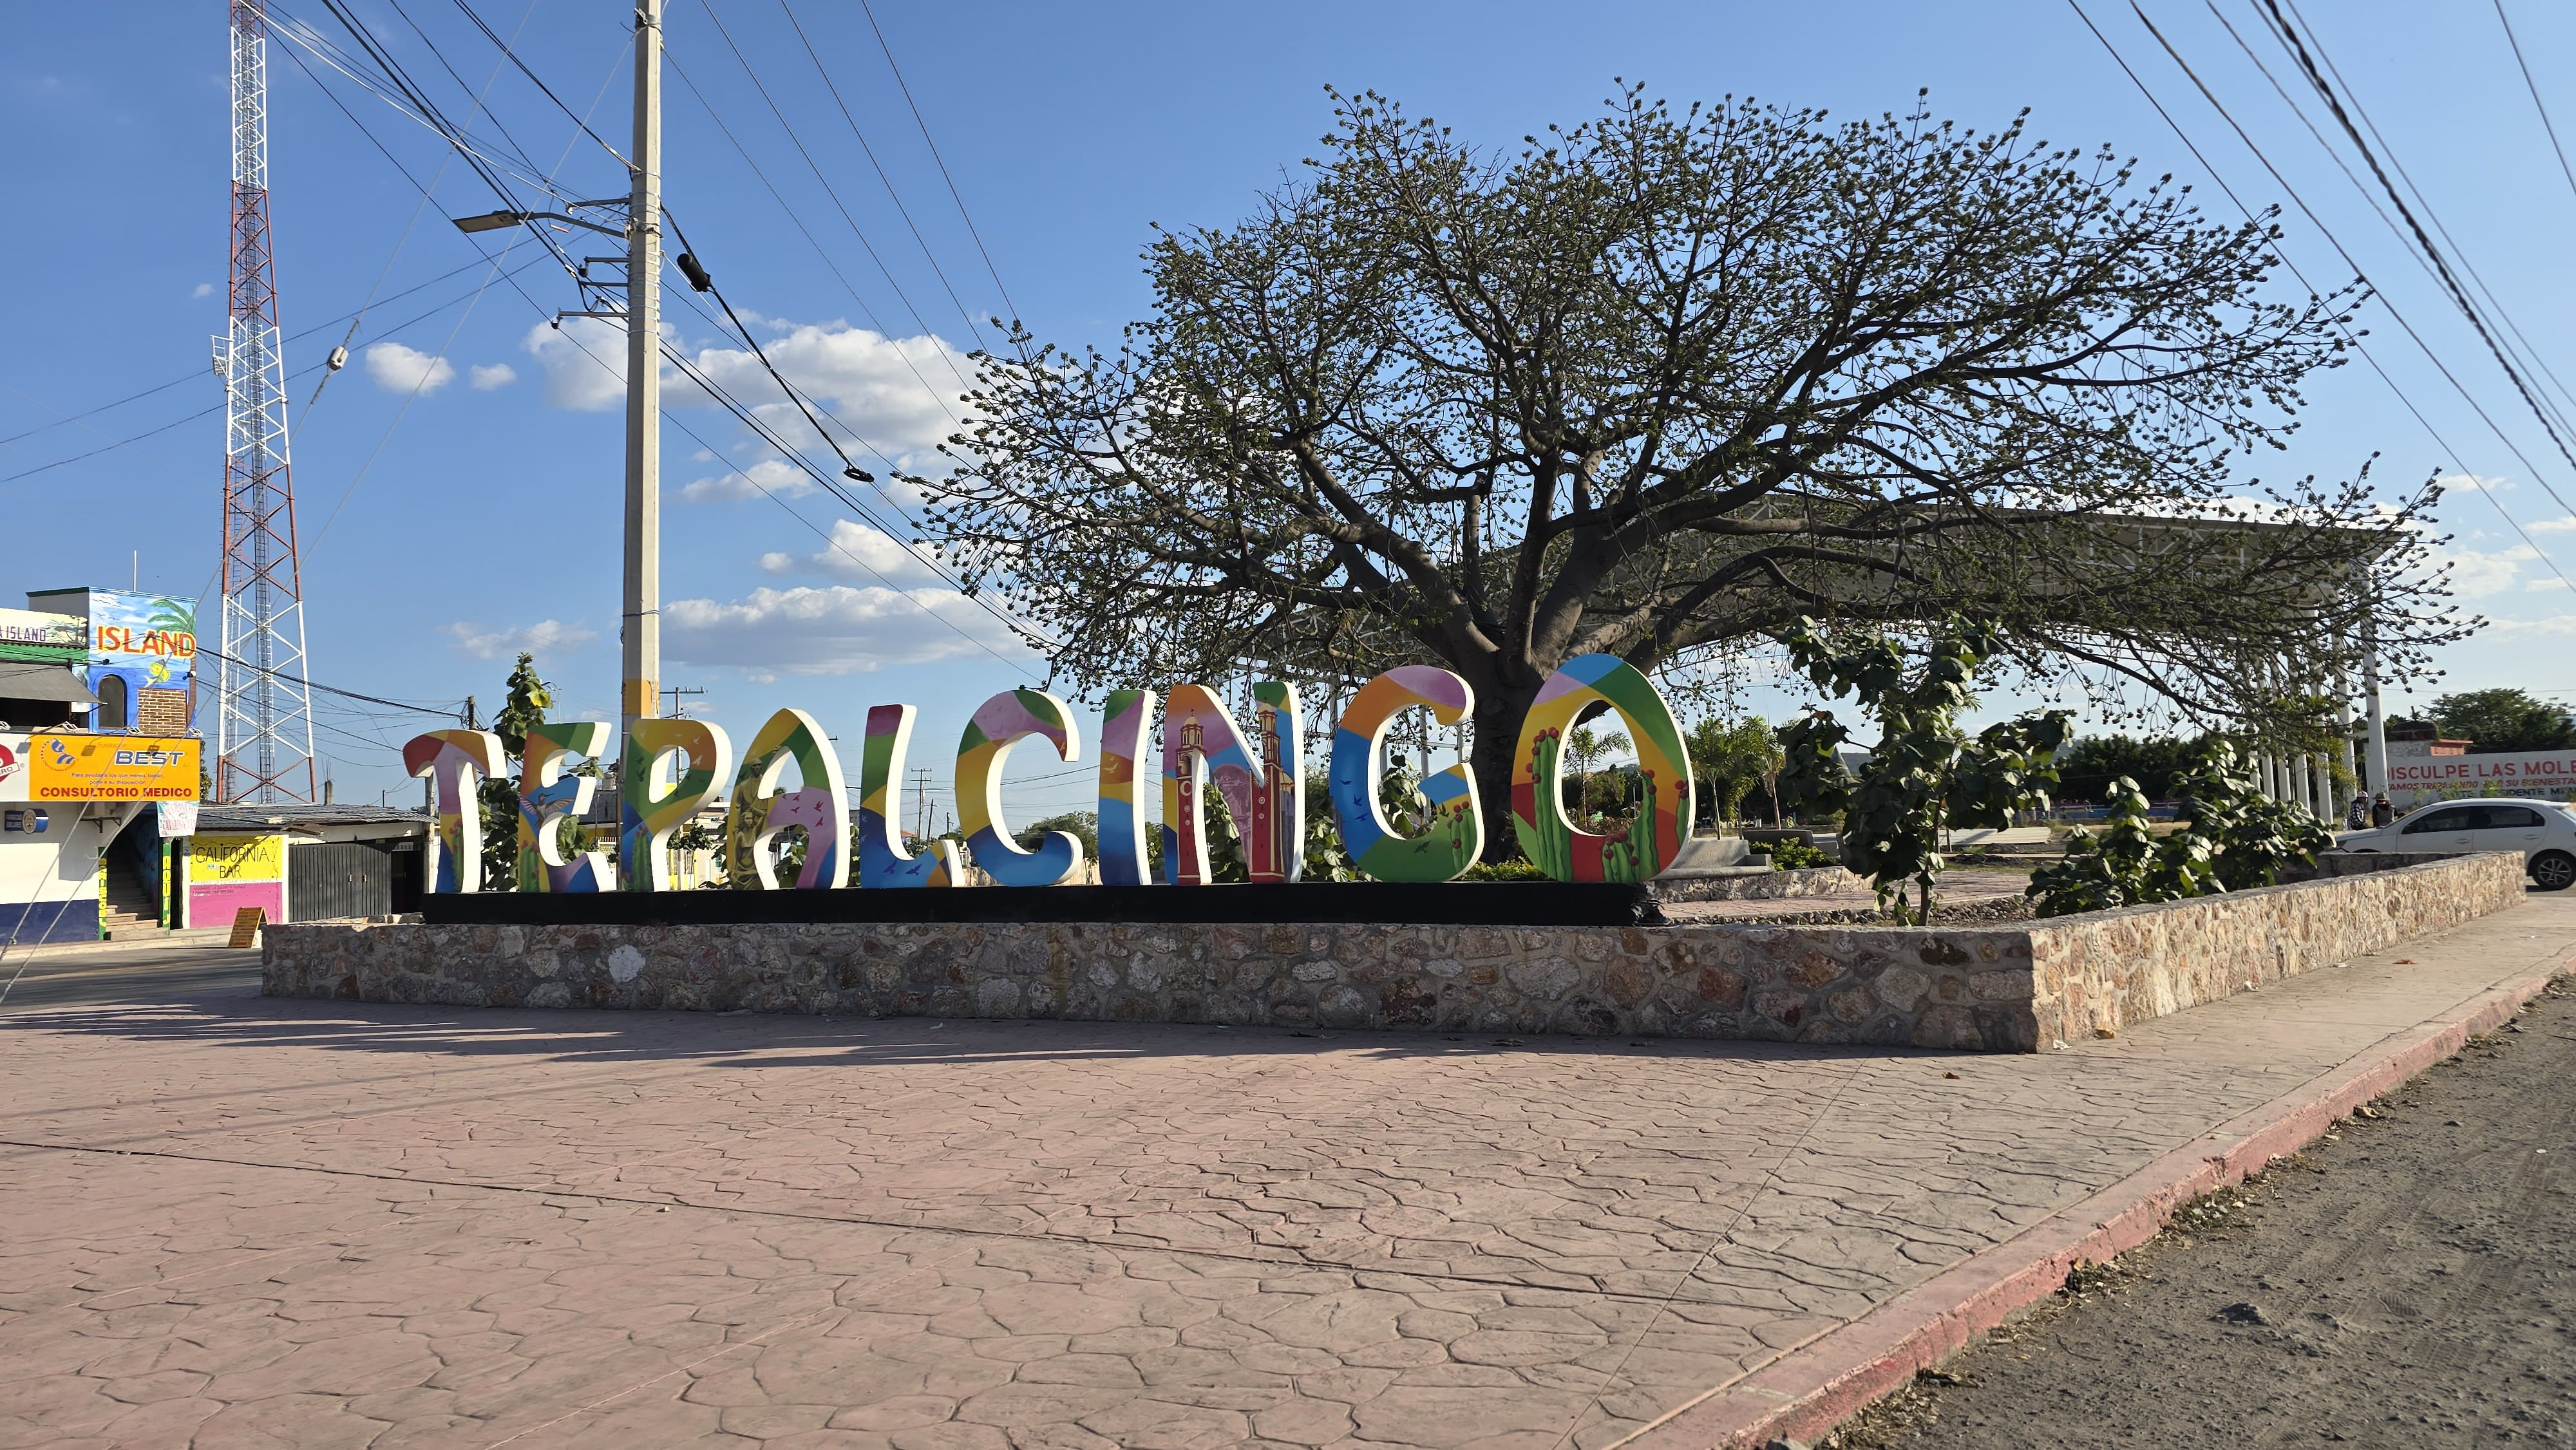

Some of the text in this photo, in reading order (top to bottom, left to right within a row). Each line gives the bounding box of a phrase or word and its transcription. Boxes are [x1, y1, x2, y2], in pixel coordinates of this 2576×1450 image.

[6, 626, 46, 641] ISLAND
[98, 626, 196, 657] ISLAND
[115, 750, 184, 766] BEST
[0, 766, 13, 776] RO
[404, 652, 1696, 895] TEPALCINGO
[2387, 764, 2470, 780] ISCULPE
[2477, 762, 2516, 777] LAS
[41, 787, 192, 797] CONSULTORIO MEDICO
[2388, 782, 2420, 791] AMOS
[2506, 779, 2519, 787] SU
[195, 846, 269, 863] CALIFORNIA
[220, 864, 242, 879] BAR
